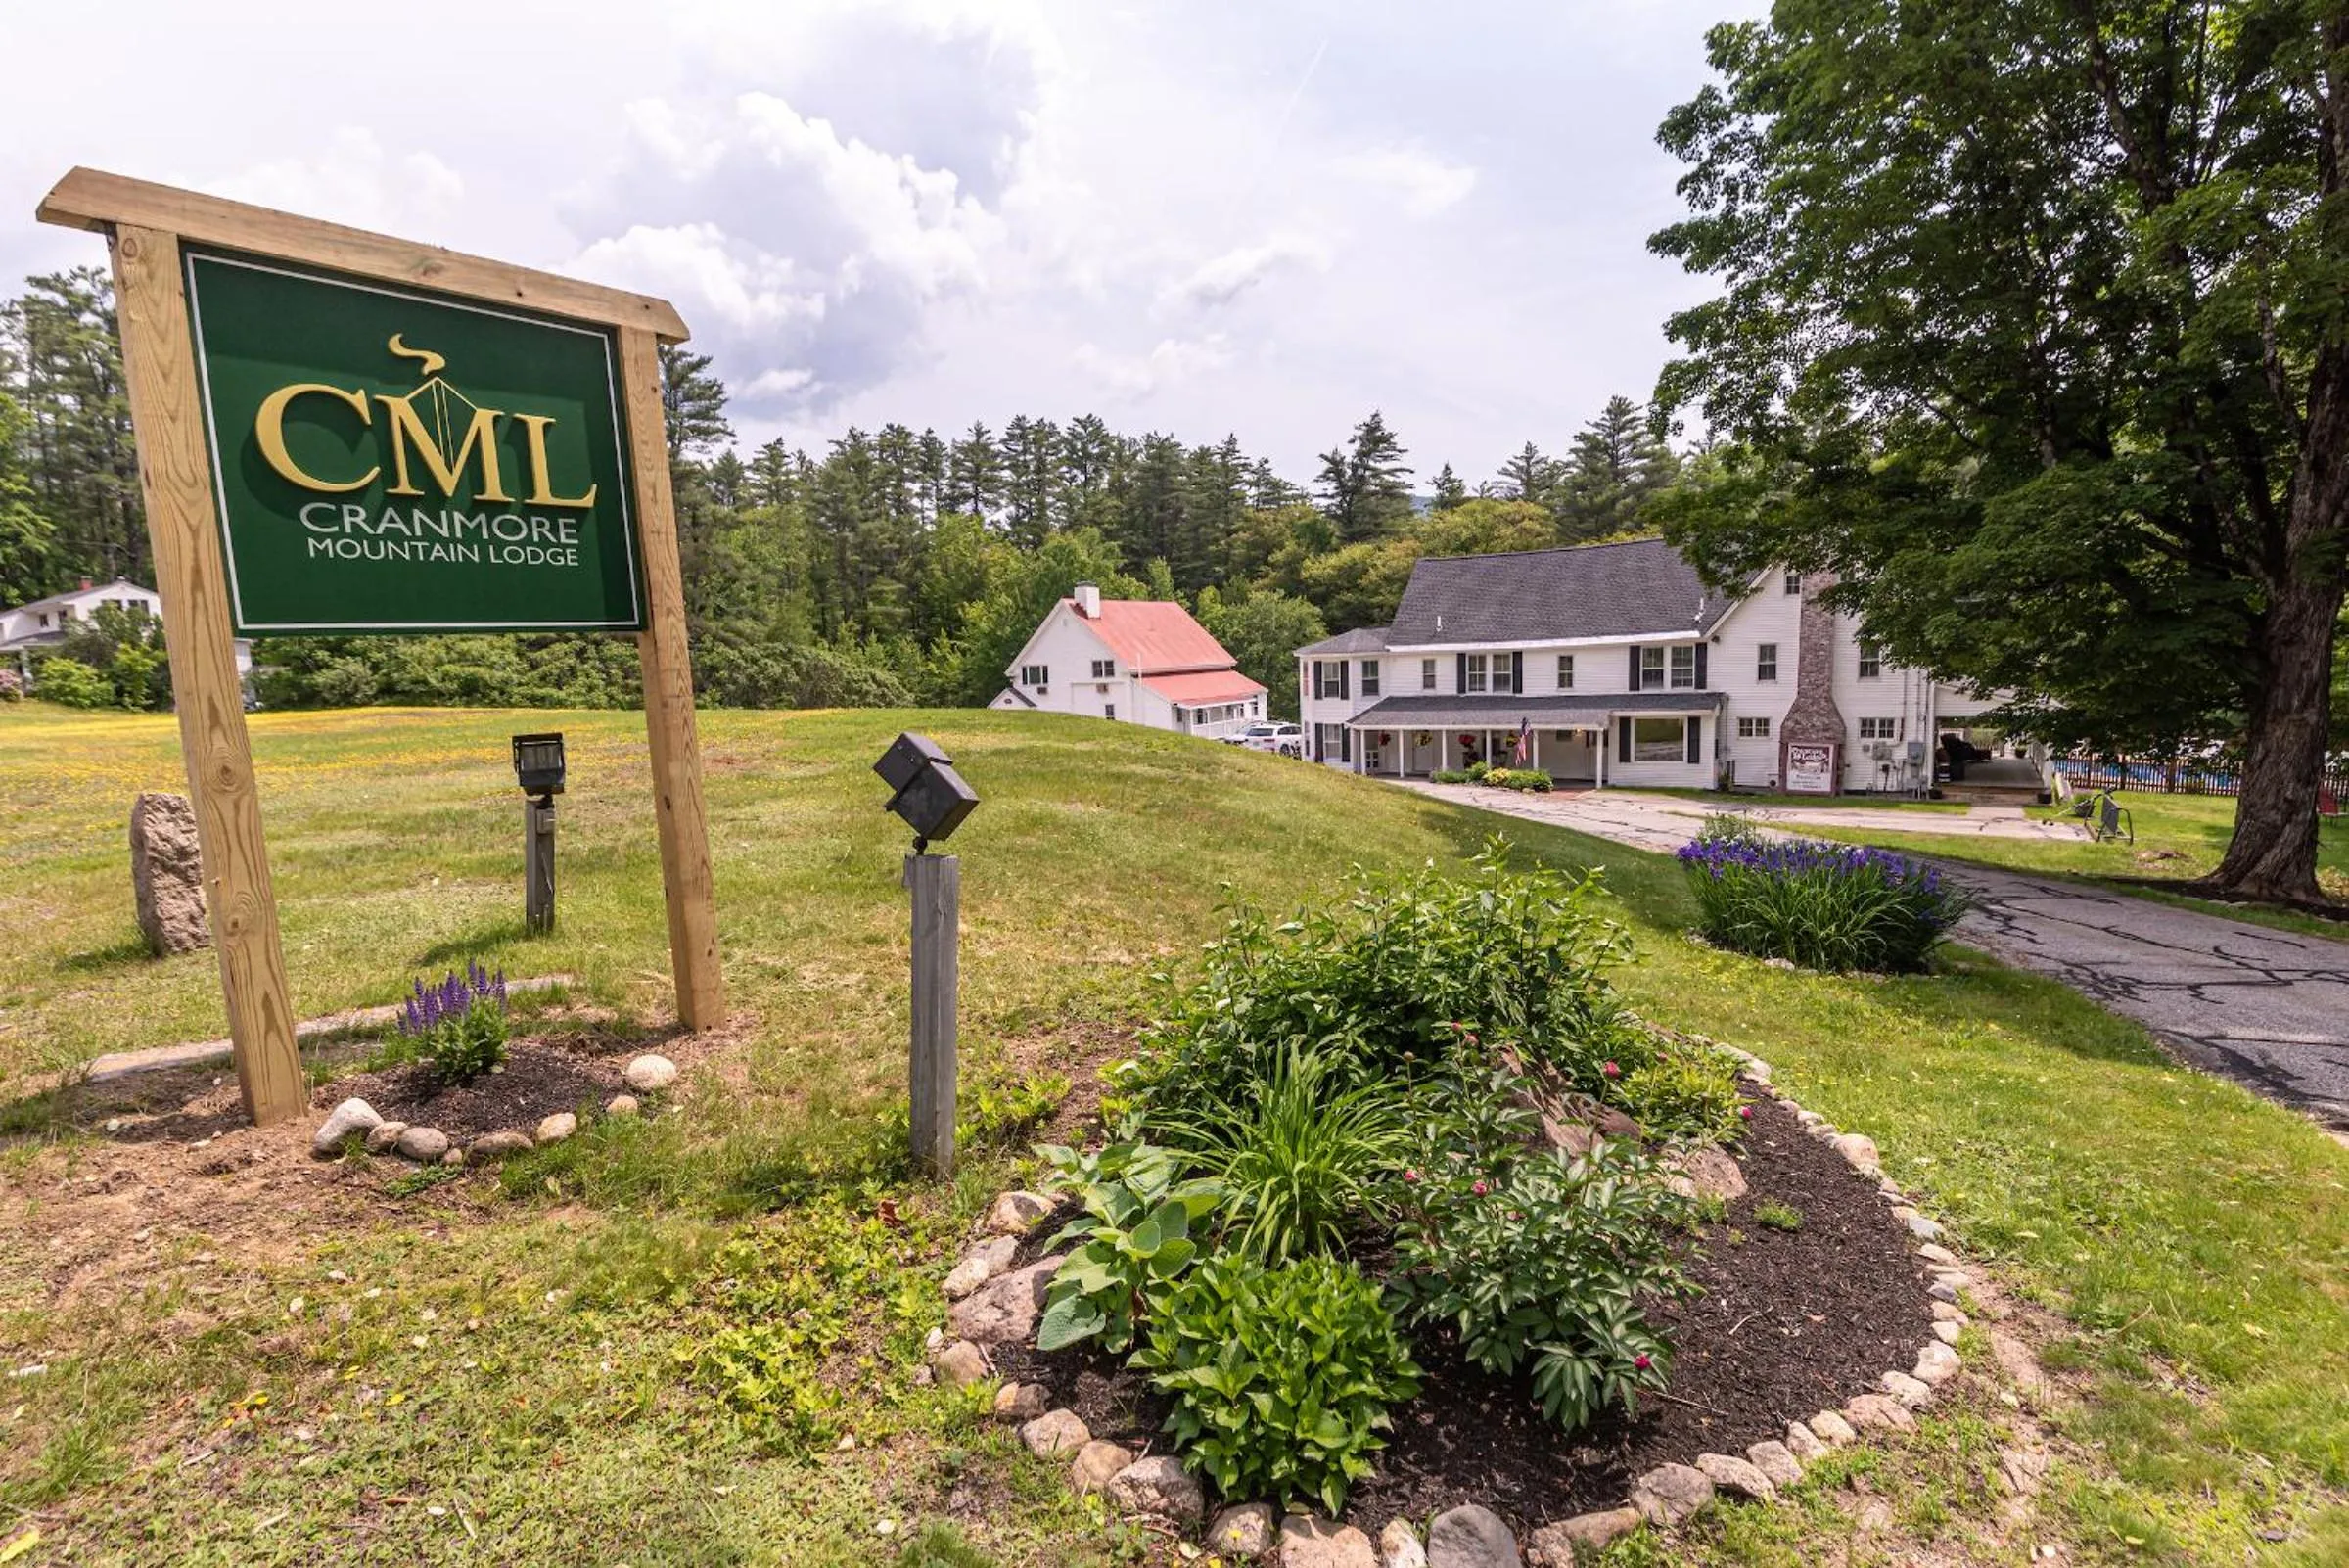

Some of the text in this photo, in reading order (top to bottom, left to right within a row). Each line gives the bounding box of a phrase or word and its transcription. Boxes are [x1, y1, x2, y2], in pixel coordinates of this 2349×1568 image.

[255, 377, 597, 508] CML
[299, 502, 579, 544] CRANMORE
[307, 536, 579, 567] MOUNTAIN LODGE
